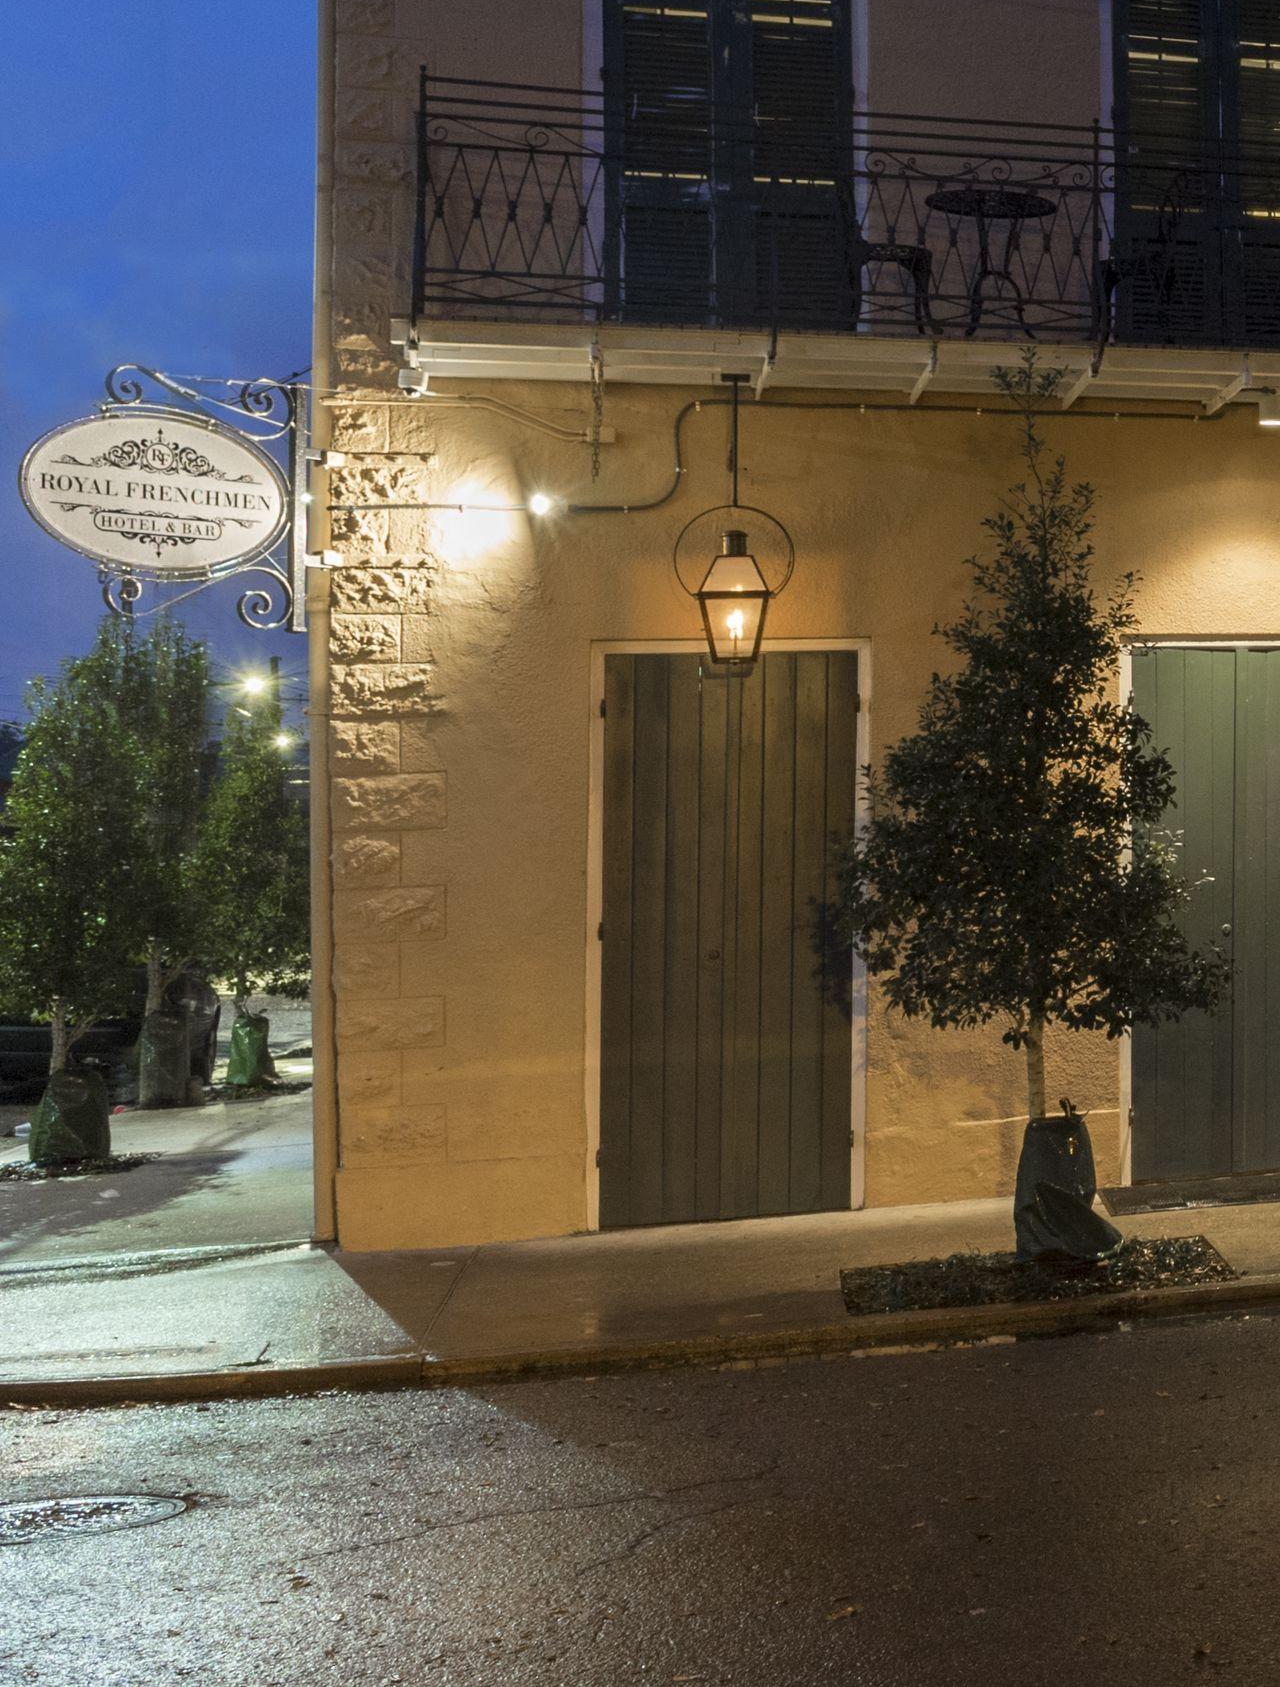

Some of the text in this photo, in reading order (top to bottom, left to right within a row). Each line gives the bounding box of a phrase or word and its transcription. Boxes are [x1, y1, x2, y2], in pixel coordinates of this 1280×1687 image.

[40, 472, 272, 511] ROYAL FRENCHMEN
[101, 515, 215, 537] HOTEL & BAR
